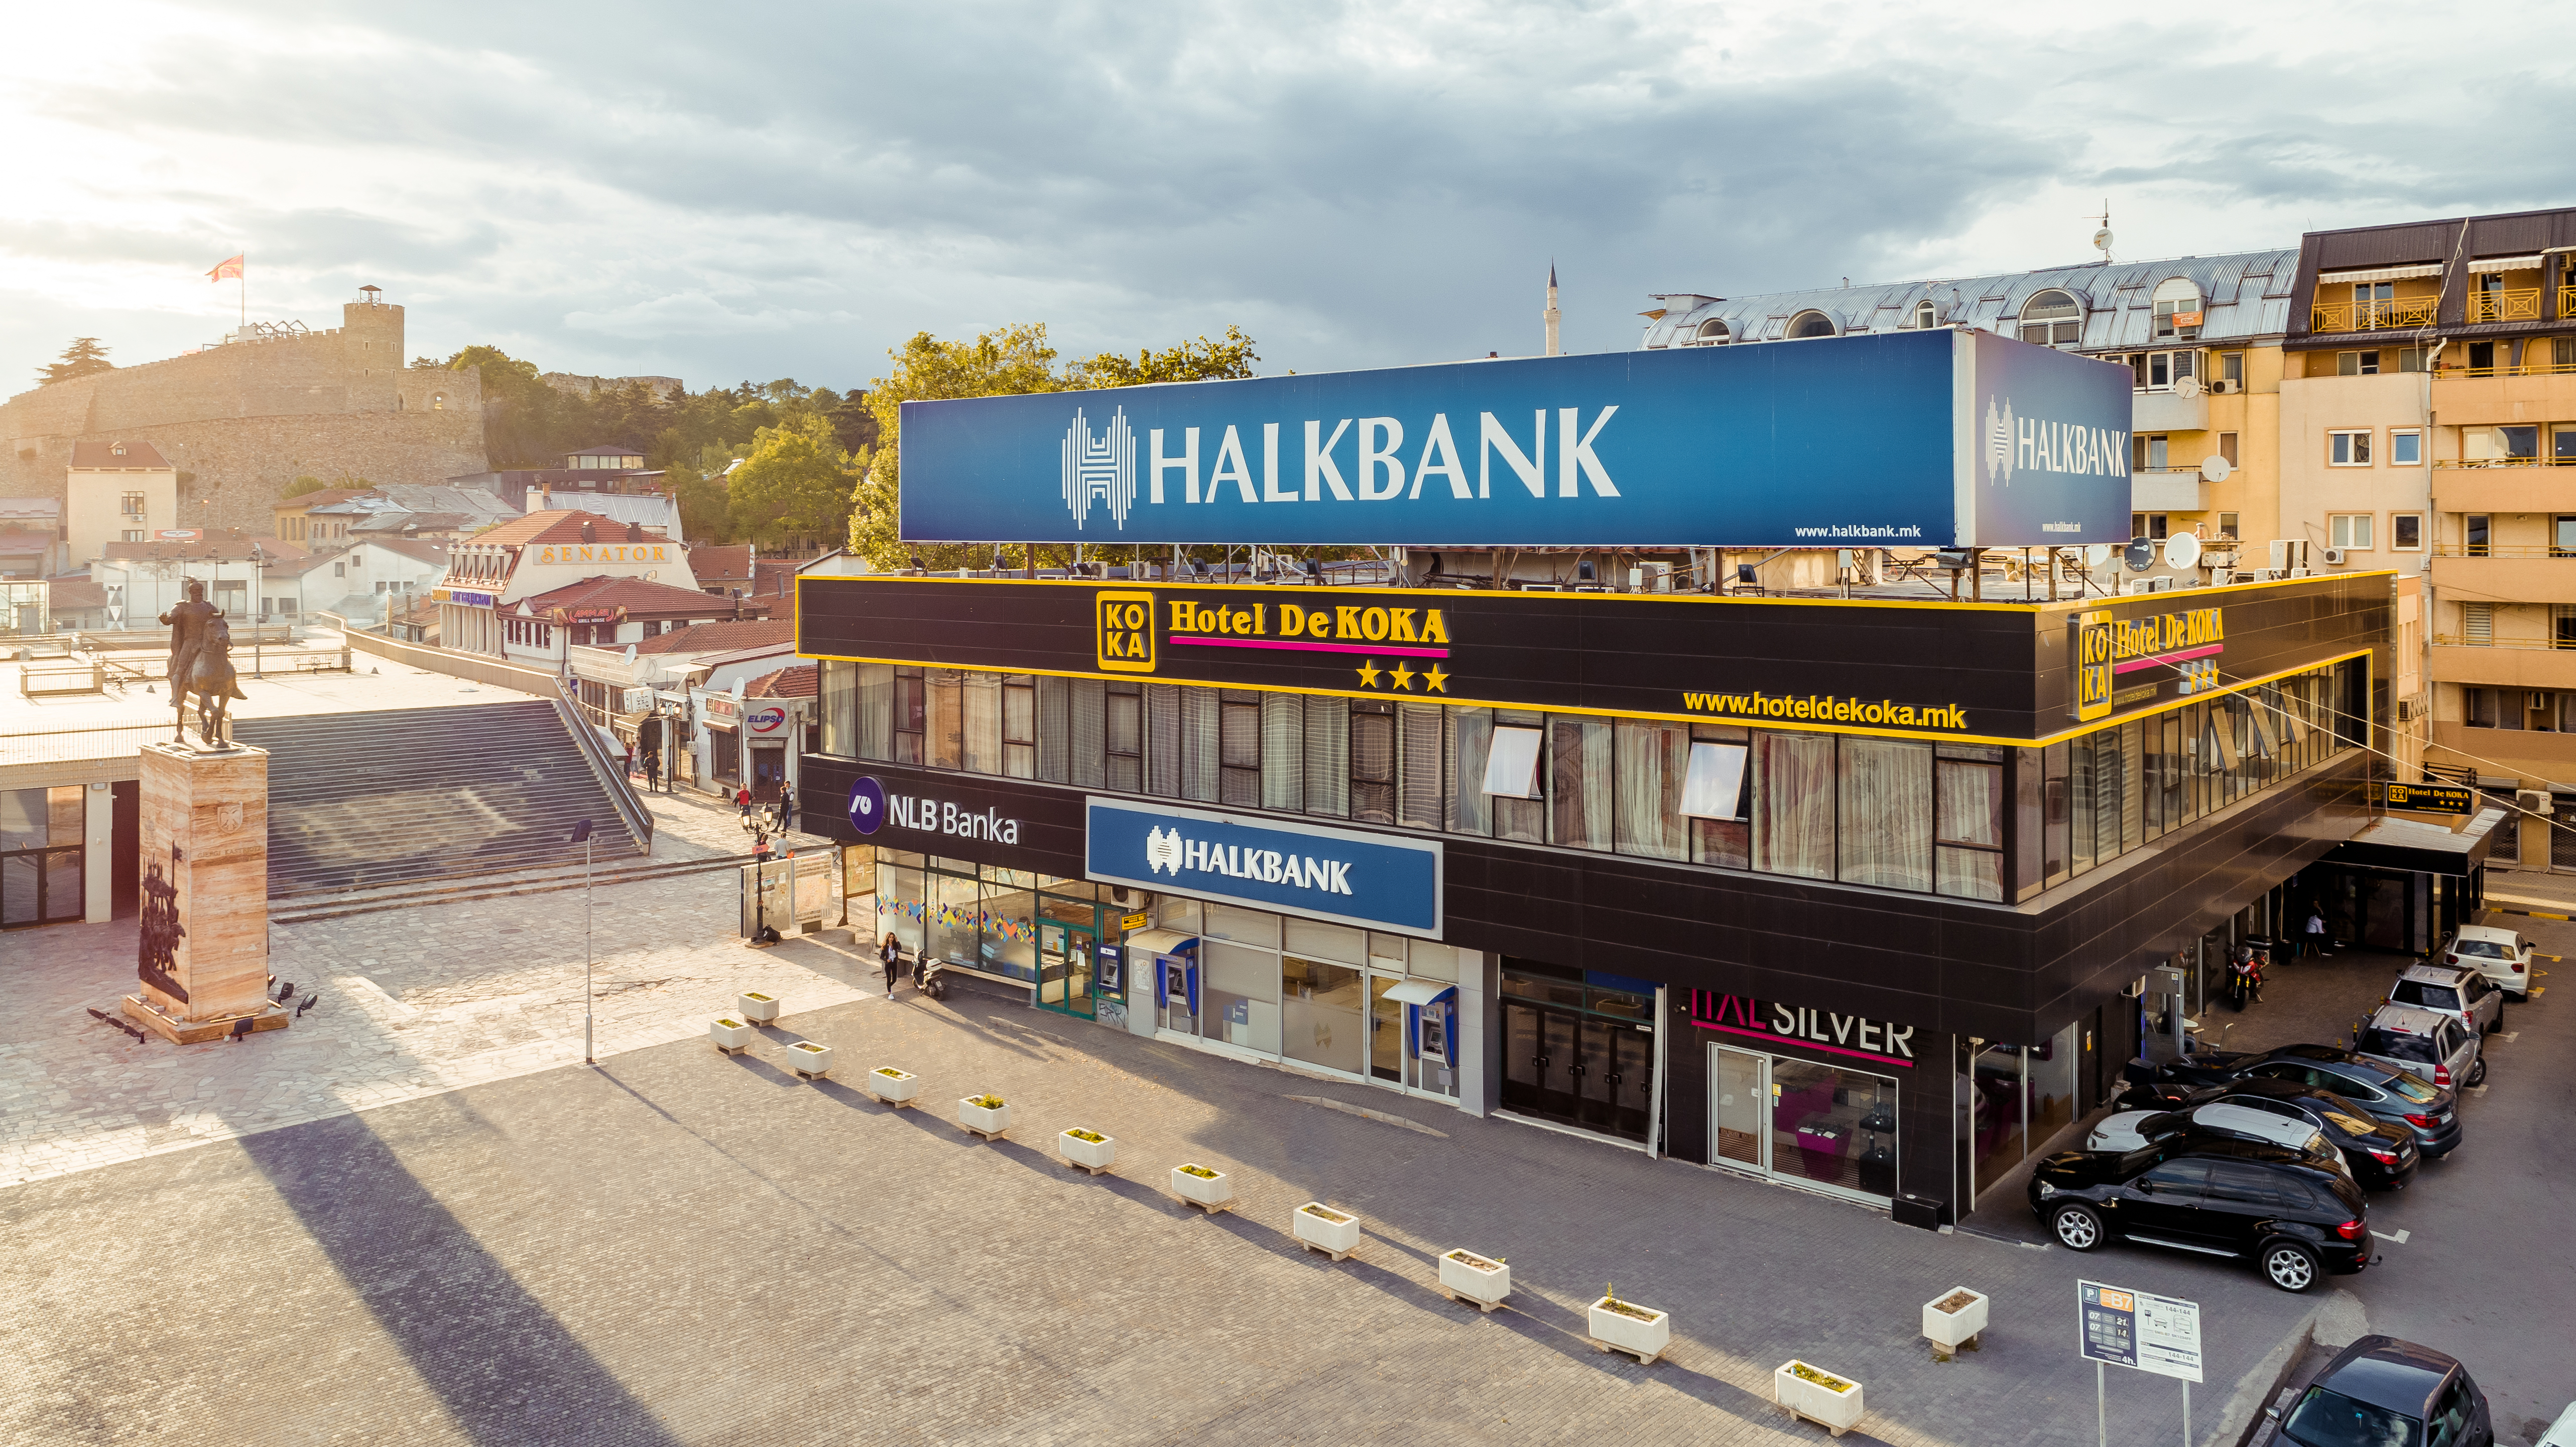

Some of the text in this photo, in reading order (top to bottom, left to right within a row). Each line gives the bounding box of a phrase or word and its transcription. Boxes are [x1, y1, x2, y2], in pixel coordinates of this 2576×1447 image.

[1150, 405, 1621, 503] HALKBANK
[2018, 416, 2126, 478] HALKBANK
[1795, 524, 1921, 537] www.halkbank.mk
[541, 546, 665, 563] SENATOR
[574, 609, 609, 618] AMMAR
[1106, 603, 1145, 630] KO
[1169, 600, 1450, 643] Hotel De KOKA
[1107, 632, 1145, 659] KA
[2084, 628, 2107, 664] KO
[2116, 608, 2224, 659] Hotel De KOKA
[2084, 665, 2107, 702] KA
[747, 715, 784, 723] ELIPSO
[1683, 692, 1967, 729] www.hoteldekoka.mk
[2408, 788, 2430, 796] Hotel
[2446, 791, 2469, 799] KOKA
[890, 795, 1019, 845] NLB Banka
[1185, 839, 1353, 895] HALKBANK
[2087, 1289, 2095, 1298] P
[2111, 1292, 2132, 1309] B7
[2165, 1305, 2190, 1316] 144-144
[2169, 1352, 2194, 1362] 144-144
